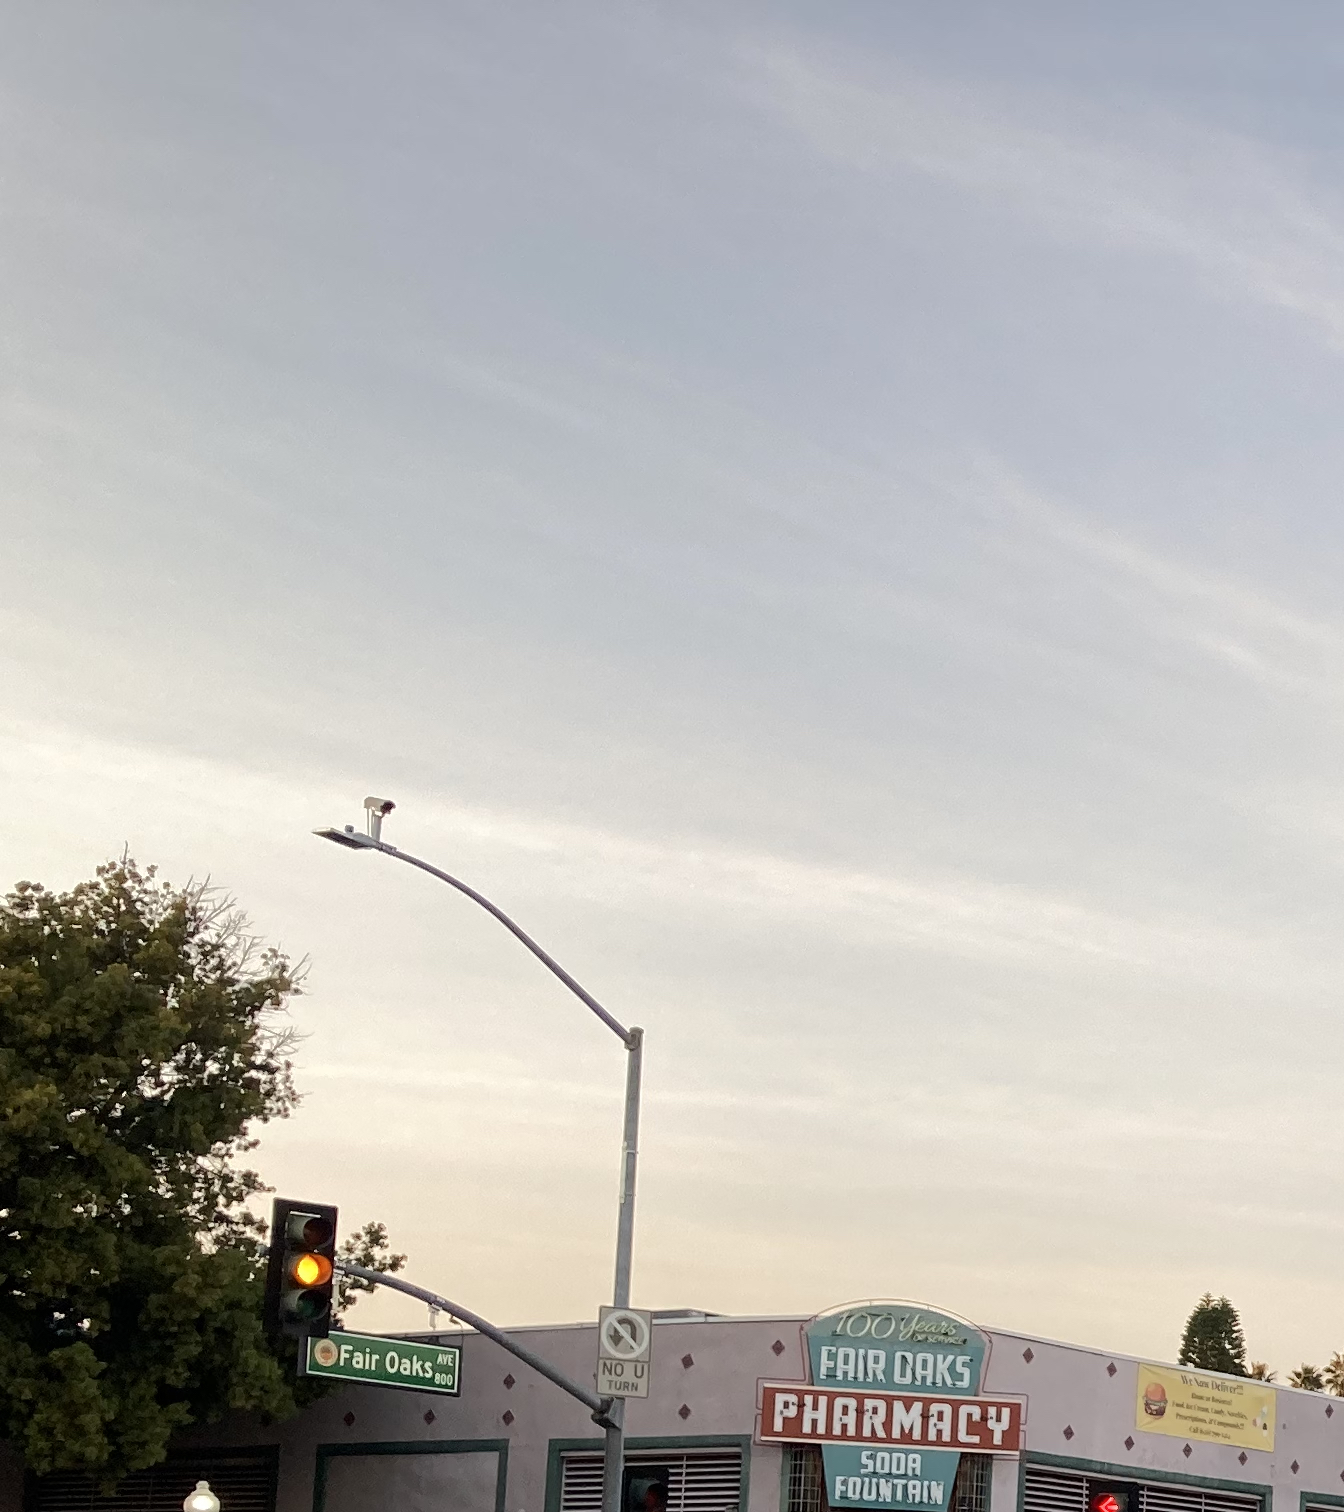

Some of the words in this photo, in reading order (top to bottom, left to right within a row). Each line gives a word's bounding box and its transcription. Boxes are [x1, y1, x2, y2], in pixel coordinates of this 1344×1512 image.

[834, 1312, 896, 1339] 100
[900, 1313, 958, 1341] Years
[339, 1344, 380, 1371] Fair
[385, 1351, 432, 1378] Oaks
[436, 1353, 454, 1366] AVE
[602, 1361, 624, 1377] NO
[634, 1363, 645, 1378] U
[820, 1346, 887, 1383] FAIR
[893, 1351, 972, 1388] OAKS
[434, 1373, 453, 1386] 800
[607, 1379, 638, 1392] TURN
[773, 1392, 1011, 1445] PHARMACY
[860, 1450, 921, 1477] SODA
[834, 1476, 944, 1505] FOUNTAIN
